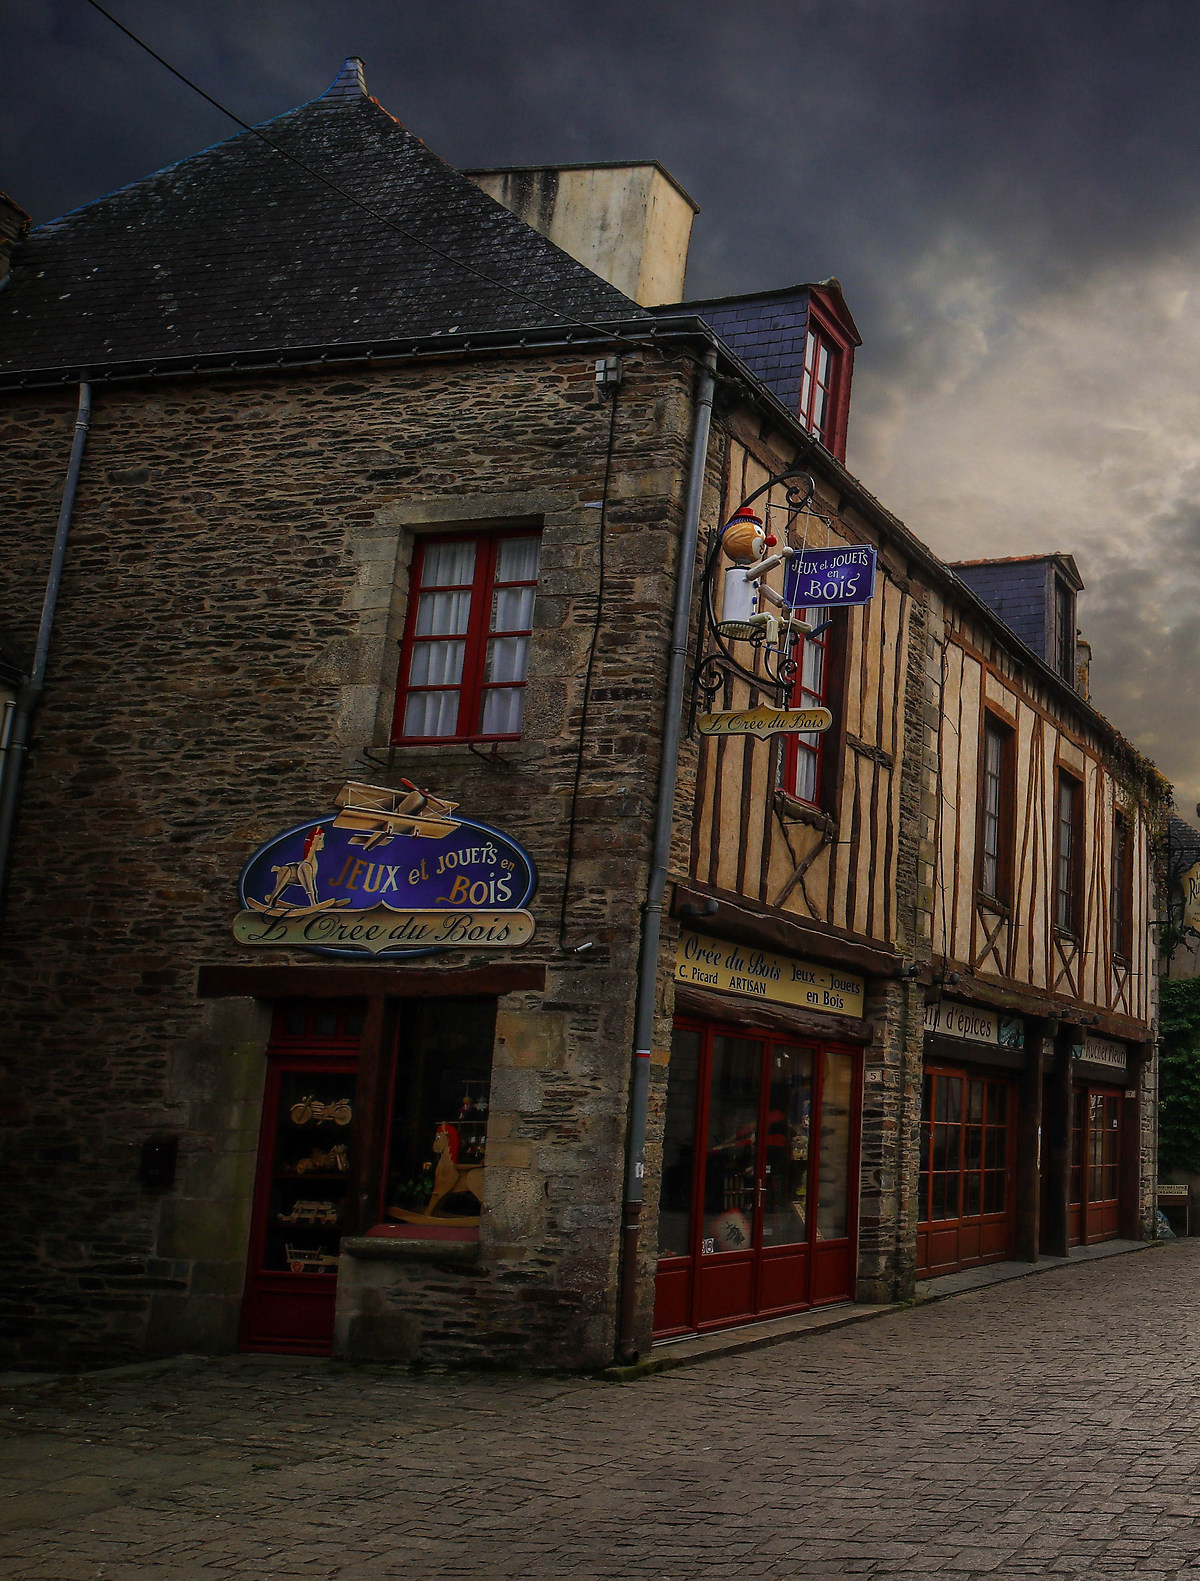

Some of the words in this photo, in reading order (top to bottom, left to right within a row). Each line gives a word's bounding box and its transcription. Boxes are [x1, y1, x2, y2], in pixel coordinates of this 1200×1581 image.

[791, 559, 818, 575] JEUX
[830, 550, 869, 569] JOUETS
[827, 570, 839, 579] en
[705, 713, 765, 732] L'Orée
[767, 713, 787, 729] du
[789, 712, 824, 729] Bois
[328, 855, 401, 894] JEUX
[408, 858, 430, 885] et
[436, 841, 498, 875] JOUETS
[501, 857, 515, 872] en
[248, 908, 387, 942] L'Orée
[388, 915, 432, 942] du
[434, 913, 511, 943] Bois
[725, 946, 744, 972] du
[748, 951, 781, 981] Bois
[791, 963, 815, 984] Jeux
[830, 973, 861, 994] Jouets
[679, 964, 688, 978] C.
[692, 967, 719, 985] Picard
[729, 976, 767, 995] ARTISAN
[806, 990, 819, 1004] en
[823, 990, 844, 1009] Bois
[946, 1006, 992, 1038] d'épices
[870, 1072, 877, 1081] 5
